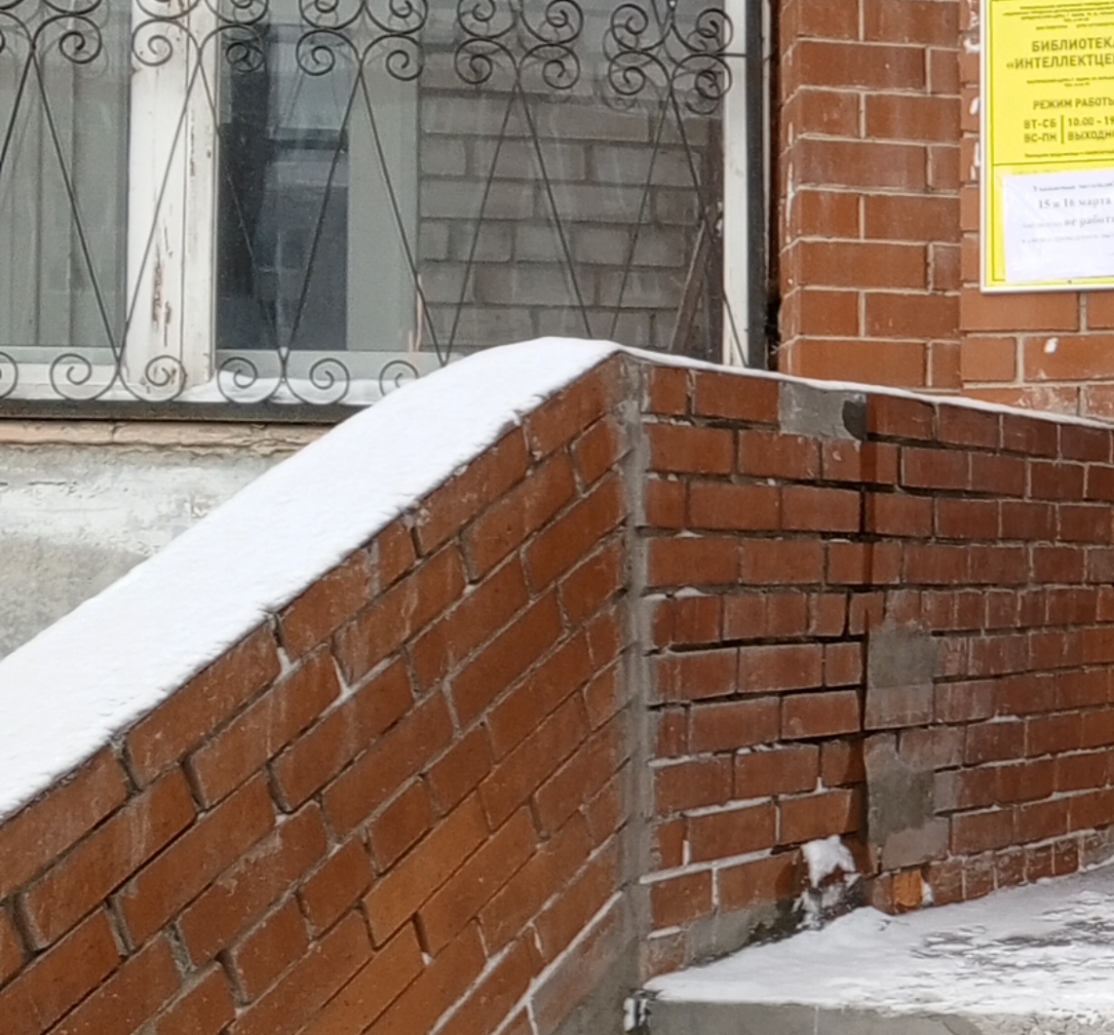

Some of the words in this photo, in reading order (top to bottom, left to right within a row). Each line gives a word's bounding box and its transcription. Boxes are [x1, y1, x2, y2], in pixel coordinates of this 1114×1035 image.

[1033, 99, 1072, 110] РЕЖИМ
[1024, 118, 1057, 129] ВТ-СБ
[1024, 132, 1057, 143] ВС-ПН
[1078, 198, 1112, 208] марта
